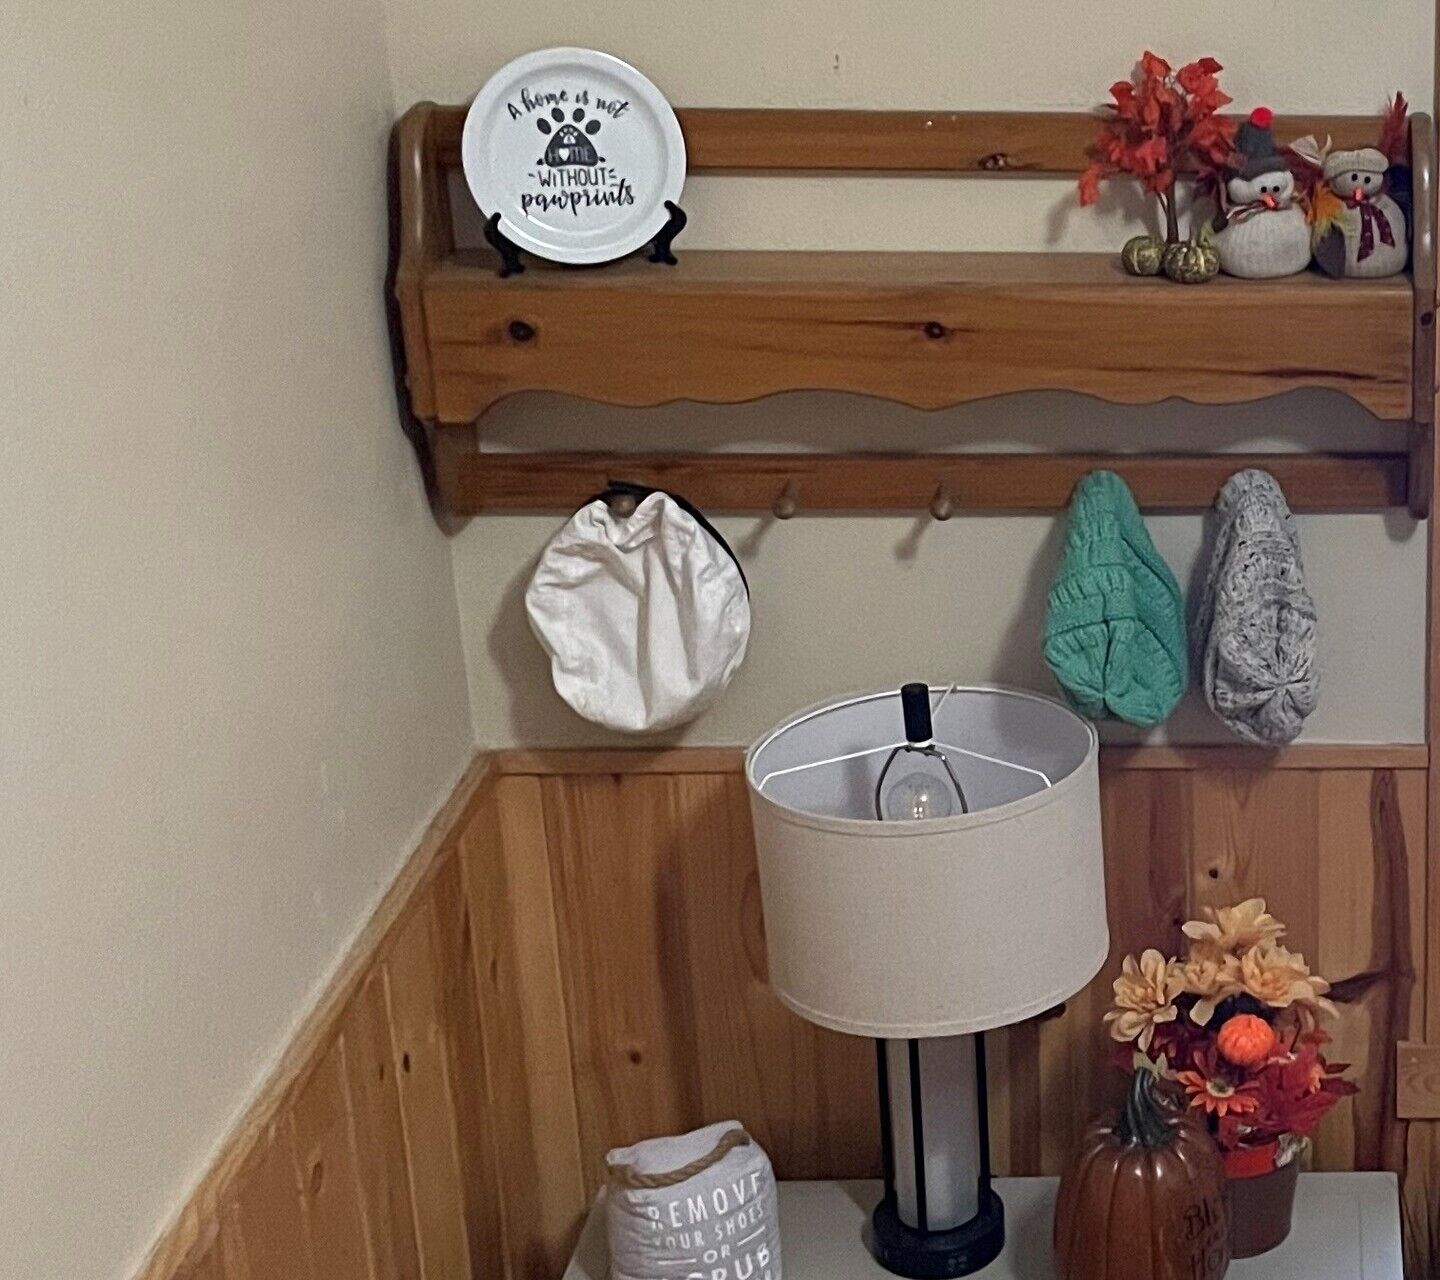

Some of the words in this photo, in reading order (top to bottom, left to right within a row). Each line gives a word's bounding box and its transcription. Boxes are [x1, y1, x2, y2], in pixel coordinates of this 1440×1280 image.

[507, 102, 523, 120] A
[521, 87, 569, 112] home
[575, 89, 590, 105] is
[596, 98, 630, 118] not
[537, 167, 607, 188] WITHOUT
[520, 178, 635, 217] pawprints
[647, 1171, 761, 1230] REMOVE
[714, 1198, 764, 1241] SHOES
[698, 1243, 731, 1264] OR
